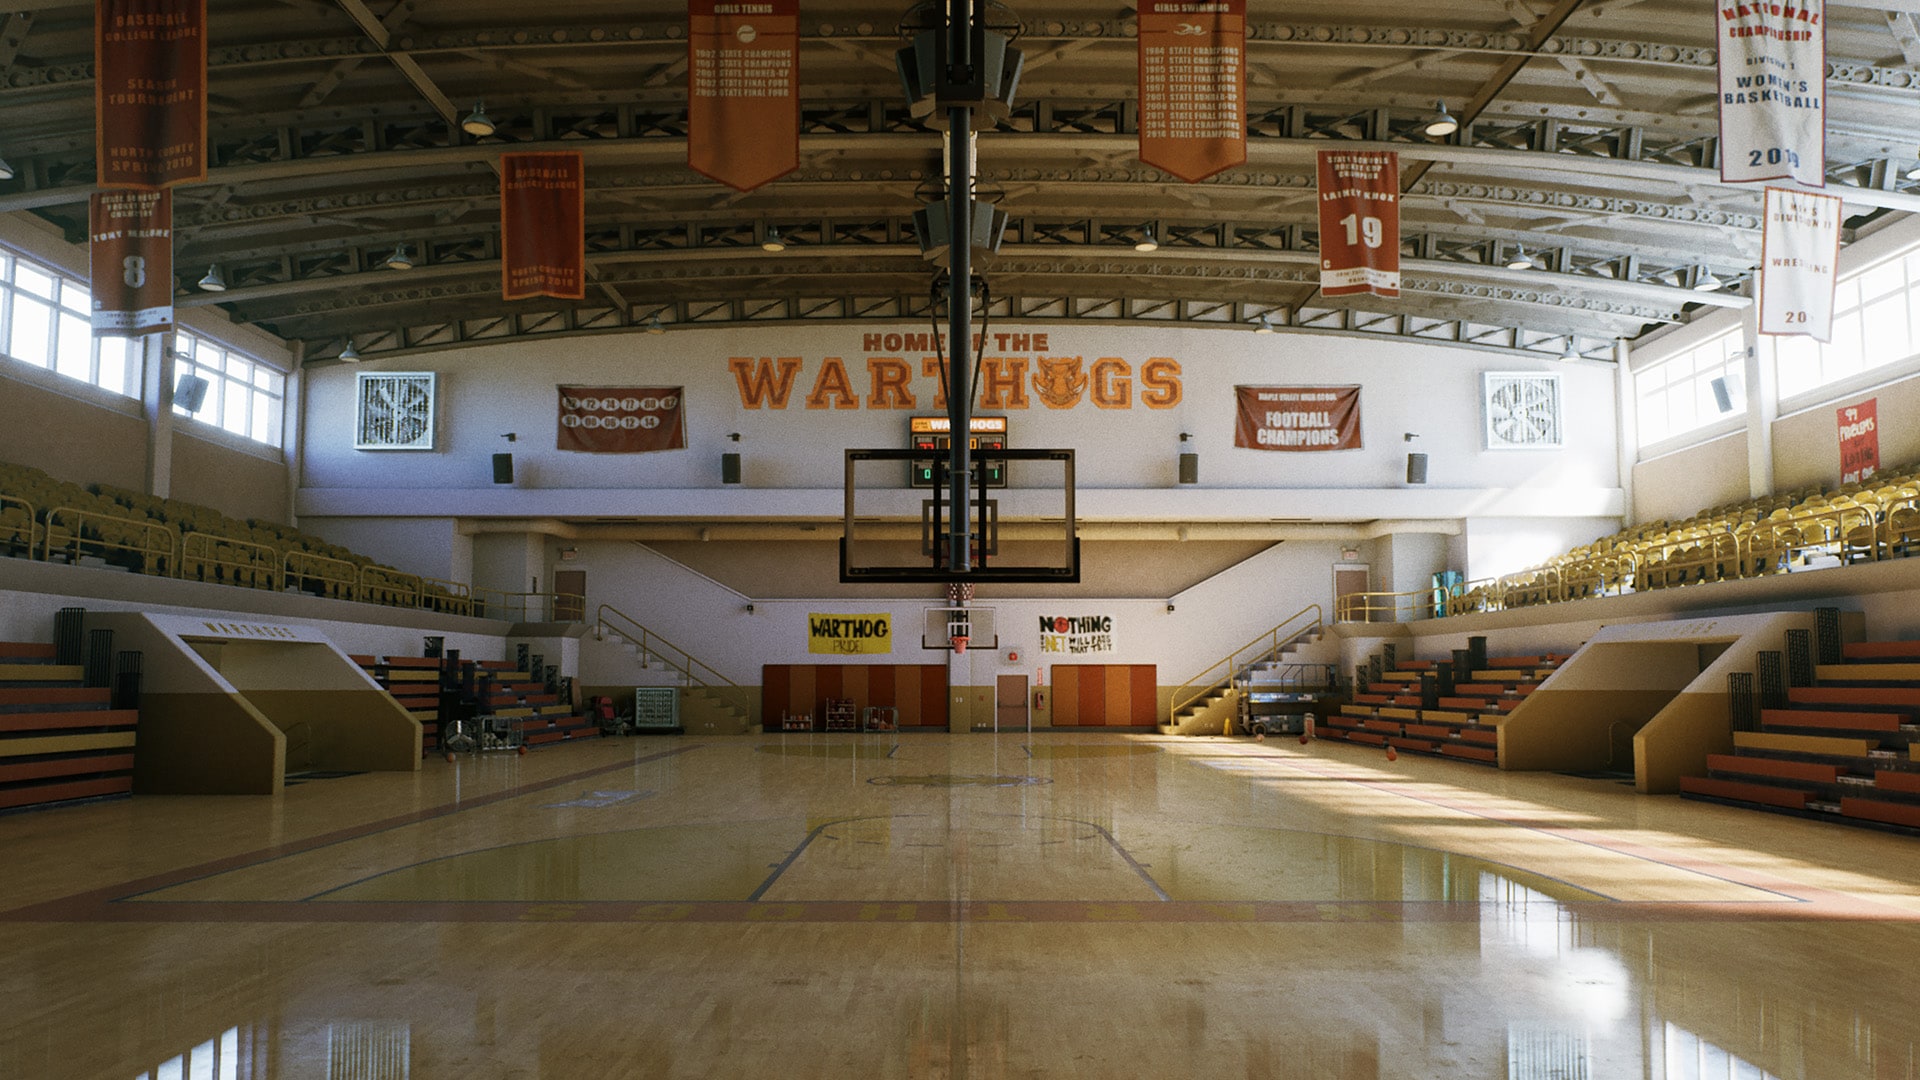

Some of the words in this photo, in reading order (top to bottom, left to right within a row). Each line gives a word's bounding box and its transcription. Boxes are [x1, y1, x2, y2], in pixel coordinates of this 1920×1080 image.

[714, 4, 740, 14] GIRLS
[742, 4, 773, 14] TENNIS
[1154, 3, 1179, 13] GIRLS
[1181, 3, 1230, 13] SWIMMING
[1722, 2, 1820, 25] NATIONAL
[116, 13, 188, 27] BASEBALL
[1729, 25, 1812, 42] CHAMPIONSHIP
[719, 49, 742, 58] STATE
[744, 49, 792, 58] CHAMPIONS
[1169, 47, 1192, 56] STATE
[1193, 47, 1239, 56] CHAMPIONS
[719, 59, 742, 68] STATE
[744, 59, 792, 68] CHAMPIONS
[1169, 56, 1192, 65] STATE
[1193, 56, 1239, 65] CHAMPIONS
[719, 69, 742, 78] STATE
[744, 69, 789, 78] RUNNER-UP
[1169, 65, 1192, 74] STATE
[719, 79, 742, 87] STATE
[744, 79, 766, 87] FINAL
[768, 79, 789, 87] FOUR
[1169, 75, 1192, 83] STATE
[1194, 75, 1215, 83] FINAL
[1218, 75, 1236, 83] FOUR
[1736, 74, 1808, 93] WOMEN'S
[719, 88, 742, 97] STATE
[744, 88, 766, 97] FINAL
[768, 88, 789, 97] FOUR
[1169, 84, 1192, 92] STATE
[1194, 84, 1215, 92] FINAL
[1218, 84, 1236, 92] FOUR
[1169, 93, 1192, 102] STATE
[1724, 89, 1820, 109] BASKETBALL
[1169, 102, 1193, 111] STATE
[1194, 102, 1216, 111] FINAL
[1218, 102, 1237, 111] FOUR
[1169, 111, 1193, 120] STATE
[1194, 111, 1216, 120] FINAL
[1218, 111, 1237, 120] FOUR
[1170, 121, 1193, 130] STATE
[1194, 121, 1240, 130] CHAMPIONS
[1170, 130, 1193, 139] STATE
[1194, 130, 1240, 139] CHAMPIONS
[1322, 188, 1361, 201] LAINEY
[1363, 192, 1395, 203] KNOX
[93, 229, 123, 243] TONY
[1339, 213, 1383, 249] 19
[1323, 259, 1331, 269] C
[123, 255, 146, 288] 8
[863, 332, 946, 352] HOME
[993, 332, 1049, 352] THE
[1265, 411, 1331, 428] FOOTBALL
[1256, 428, 1340, 446] CHAMPIONS
[810, 617, 889, 638] WARTHOG
[1039, 615, 1113, 634] NOTHING
[1045, 635, 1067, 653] NET
[1068, 636, 1090, 646] WILL
[1091, 635, 1112, 645] PASS
[1069, 645, 1089, 654] THAT
[1091, 643, 1112, 652] TEST
